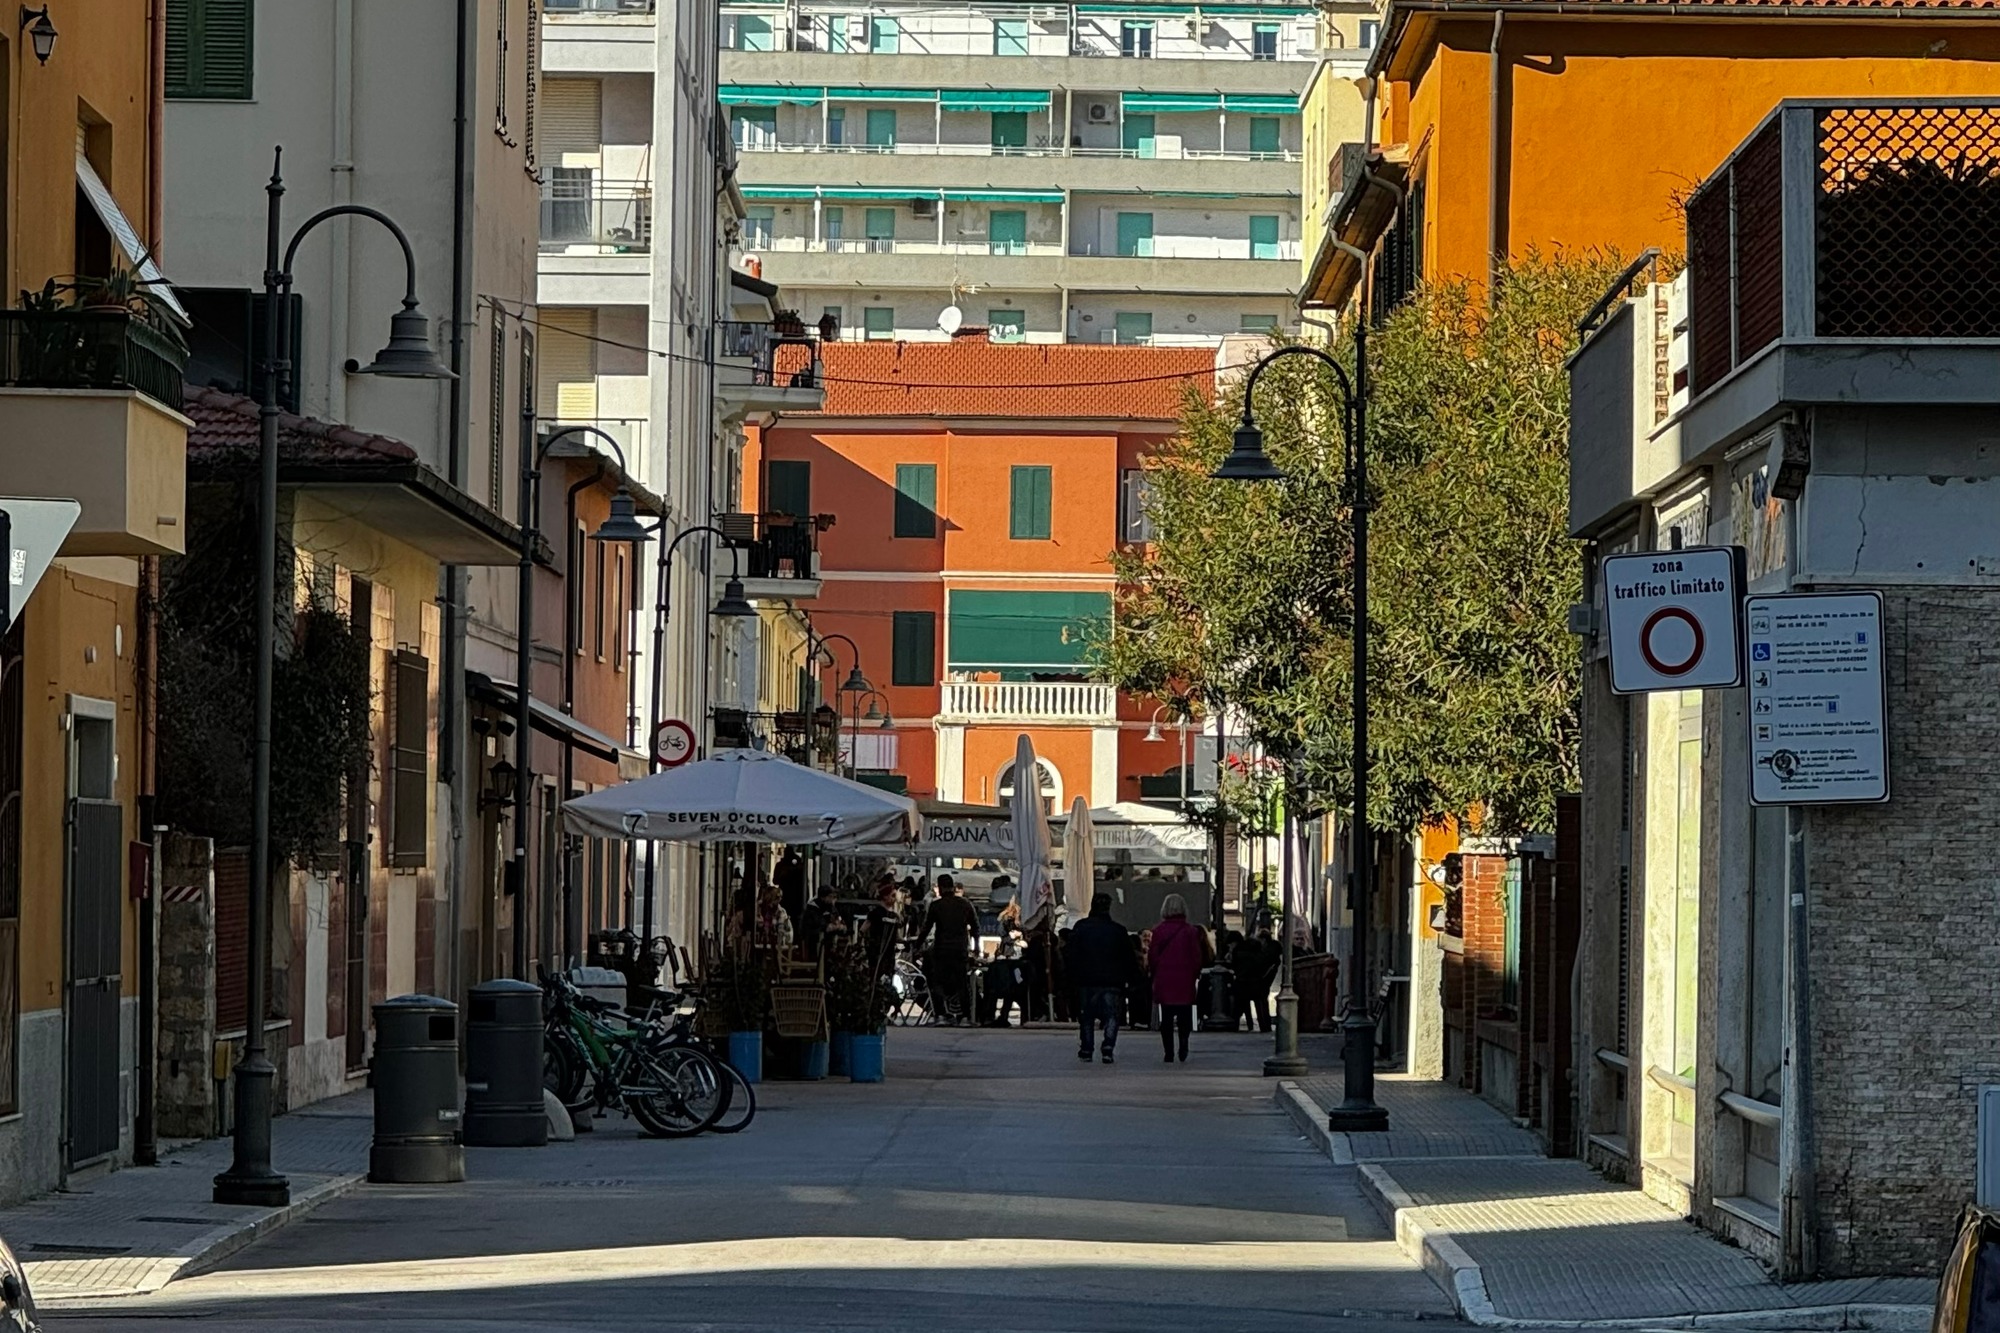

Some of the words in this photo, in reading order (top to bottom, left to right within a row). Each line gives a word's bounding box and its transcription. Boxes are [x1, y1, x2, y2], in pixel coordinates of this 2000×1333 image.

[1652, 561, 1683, 573] zona
[1614, 581, 1666, 599] traffico
[1670, 577, 1725, 595] limitato
[667, 812, 721, 824] SEVEN
[728, 812, 799, 826] O'CLOCK
[701, 824, 726, 834] Food
[728, 824, 736, 834] &
[738, 824, 766, 835] Drink
